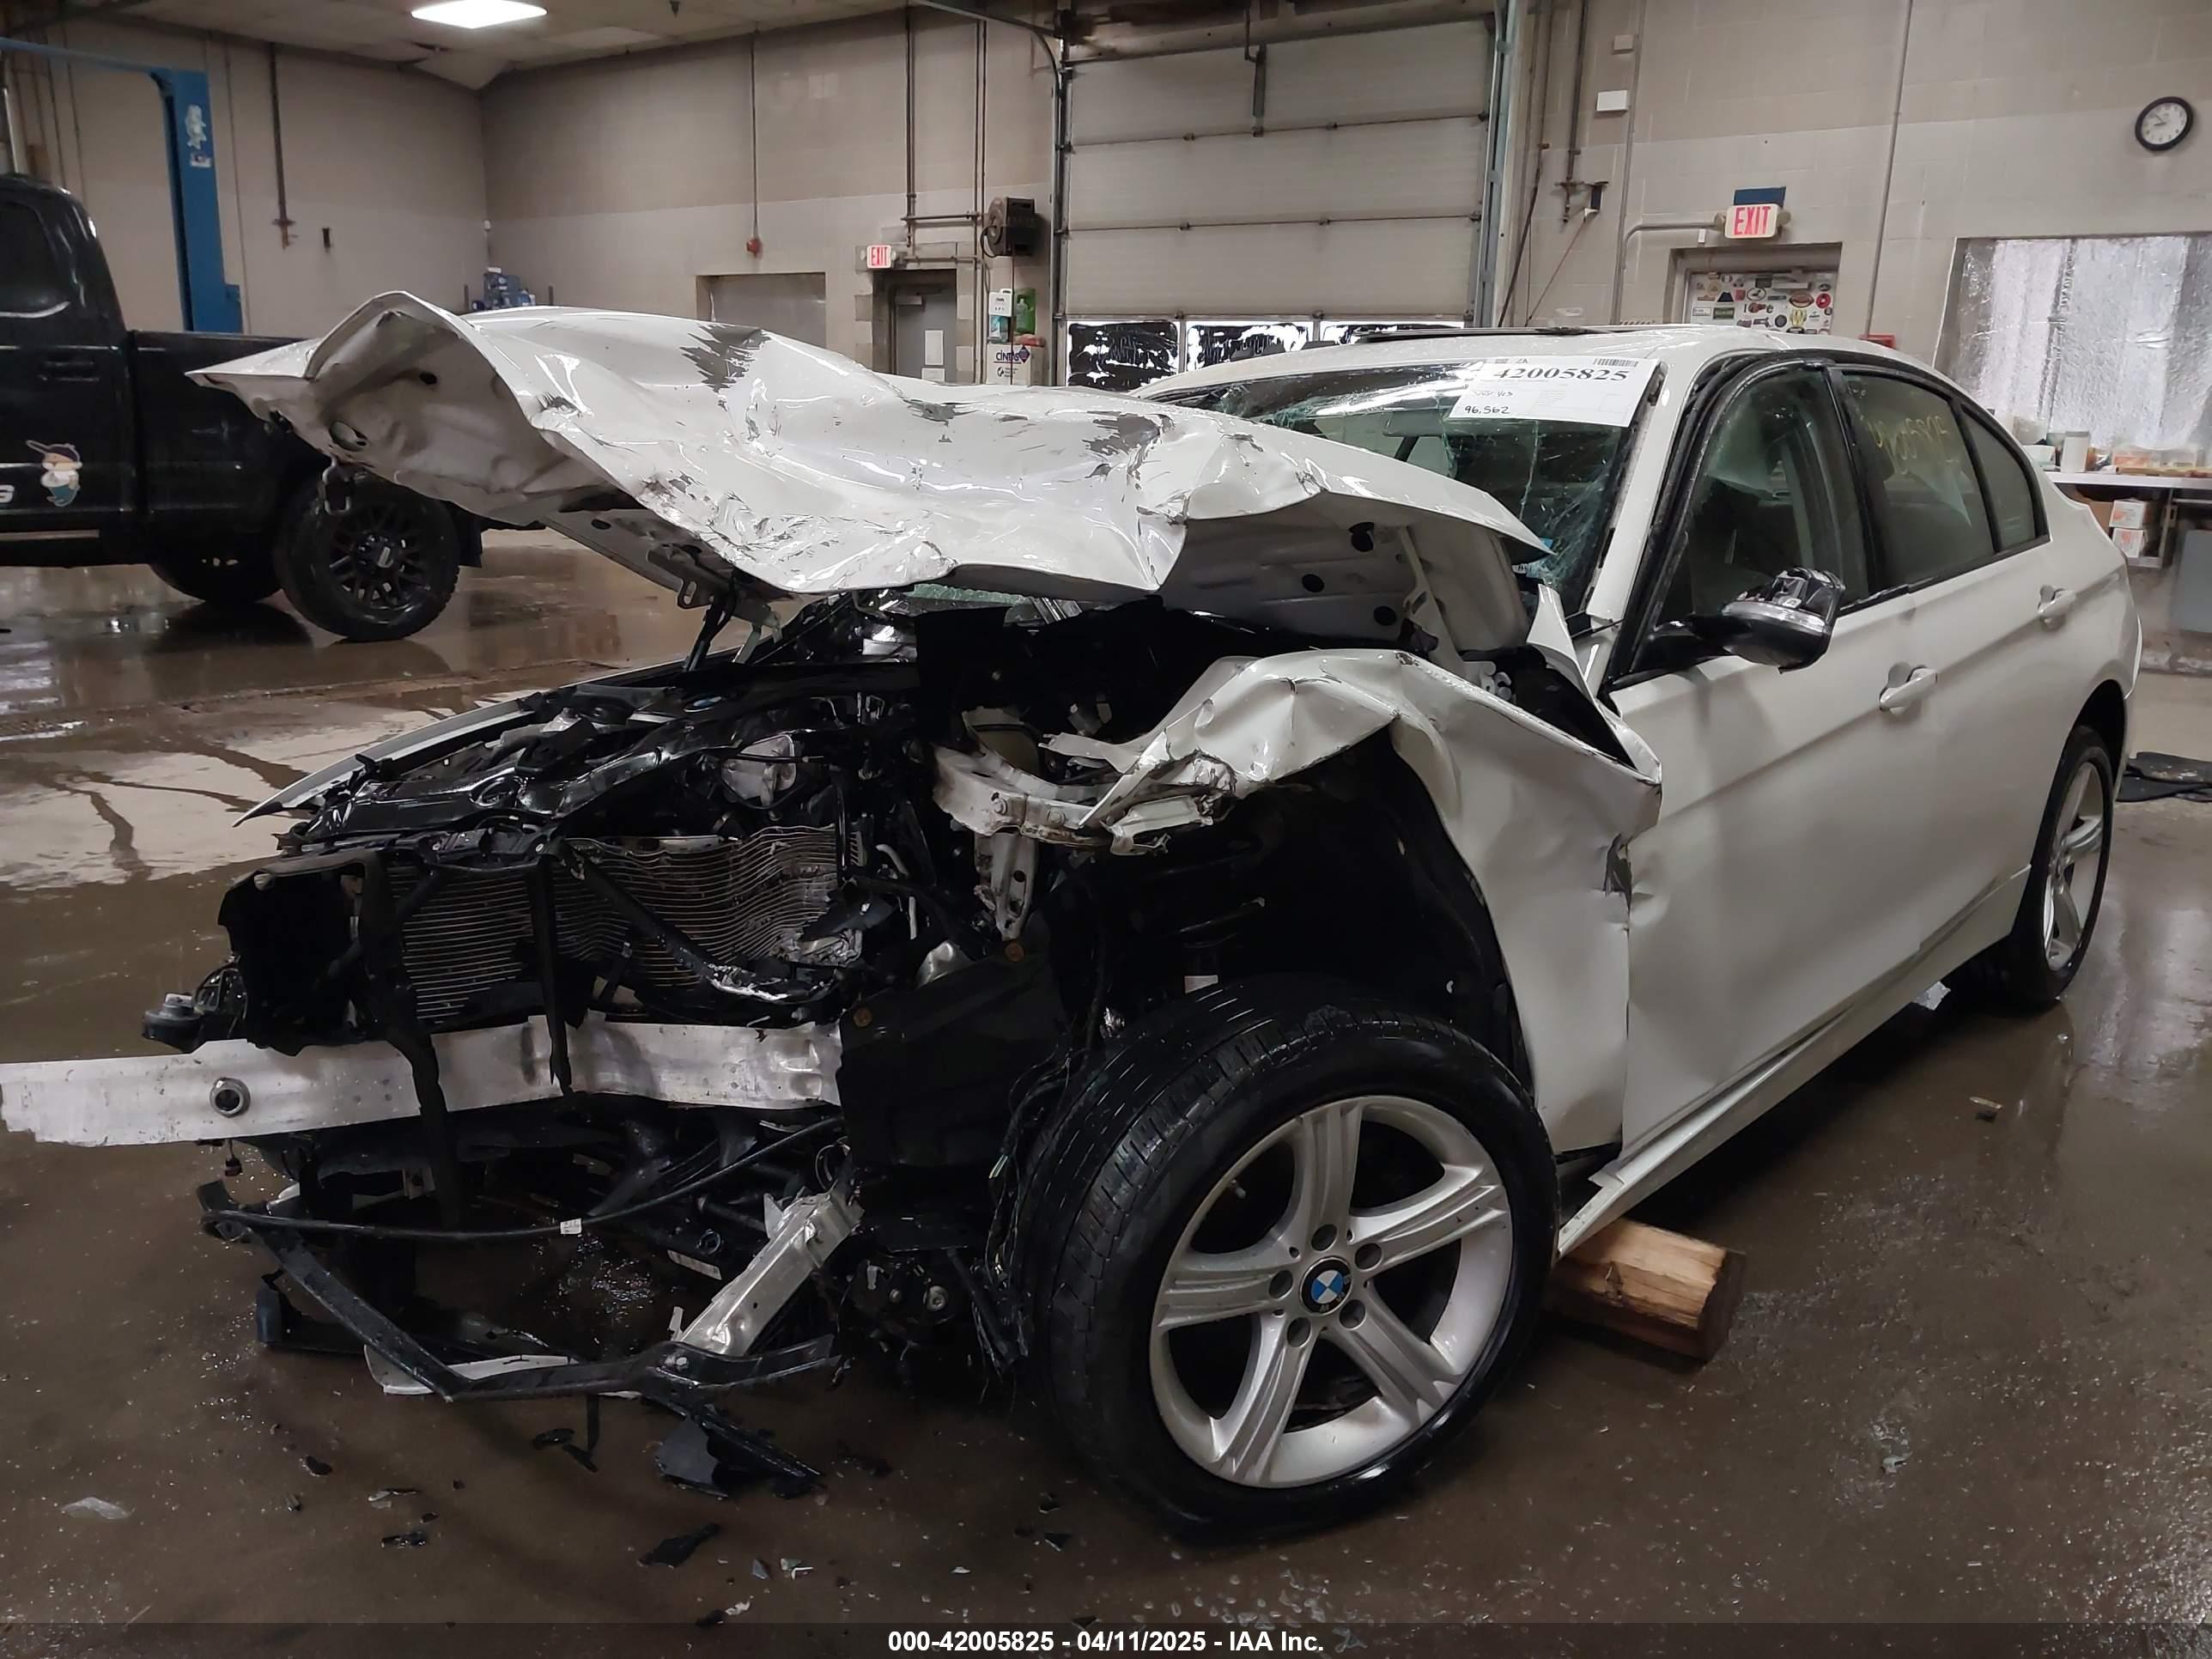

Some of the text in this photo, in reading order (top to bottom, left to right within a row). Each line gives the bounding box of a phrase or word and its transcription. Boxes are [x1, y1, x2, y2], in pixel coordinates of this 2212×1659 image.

[1733, 206, 1771, 235] EXIT
[871, 246, 888, 266] EXIT
[1493, 367, 1631, 381] 42005825
